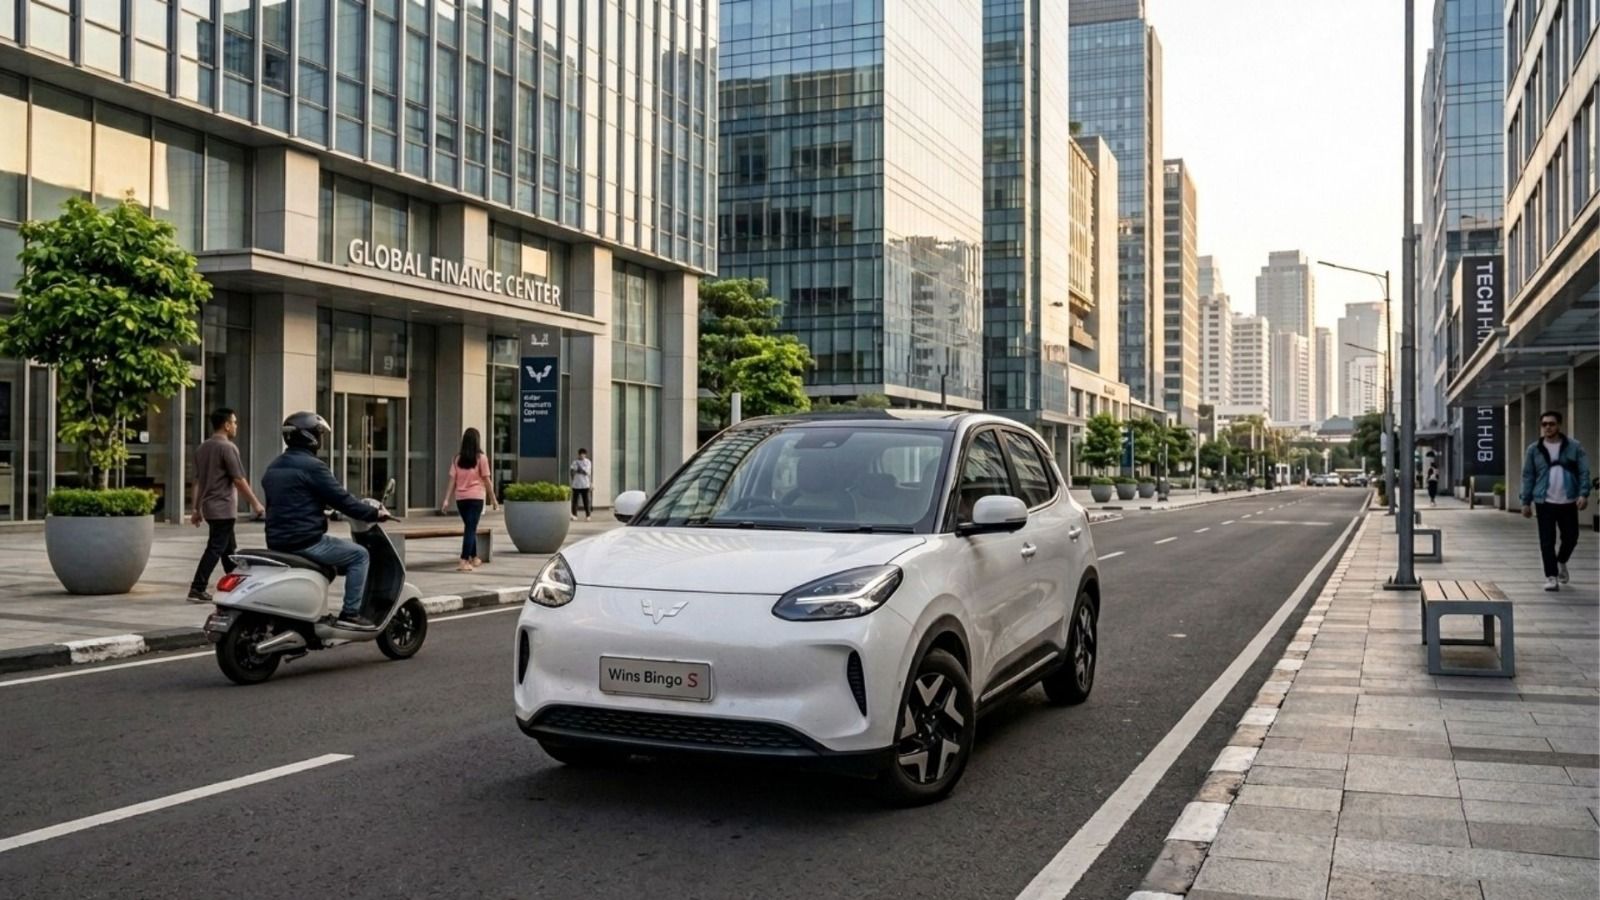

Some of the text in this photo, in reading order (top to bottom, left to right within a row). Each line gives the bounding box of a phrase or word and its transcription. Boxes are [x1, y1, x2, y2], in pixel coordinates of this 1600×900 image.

[349, 239, 561, 306] GLOBAL FINANCE CENTER
[1476, 261, 1493, 313] TECH
[1477, 425, 1493, 461] HUB
[608, 667, 698, 688] Wins Bingo S
